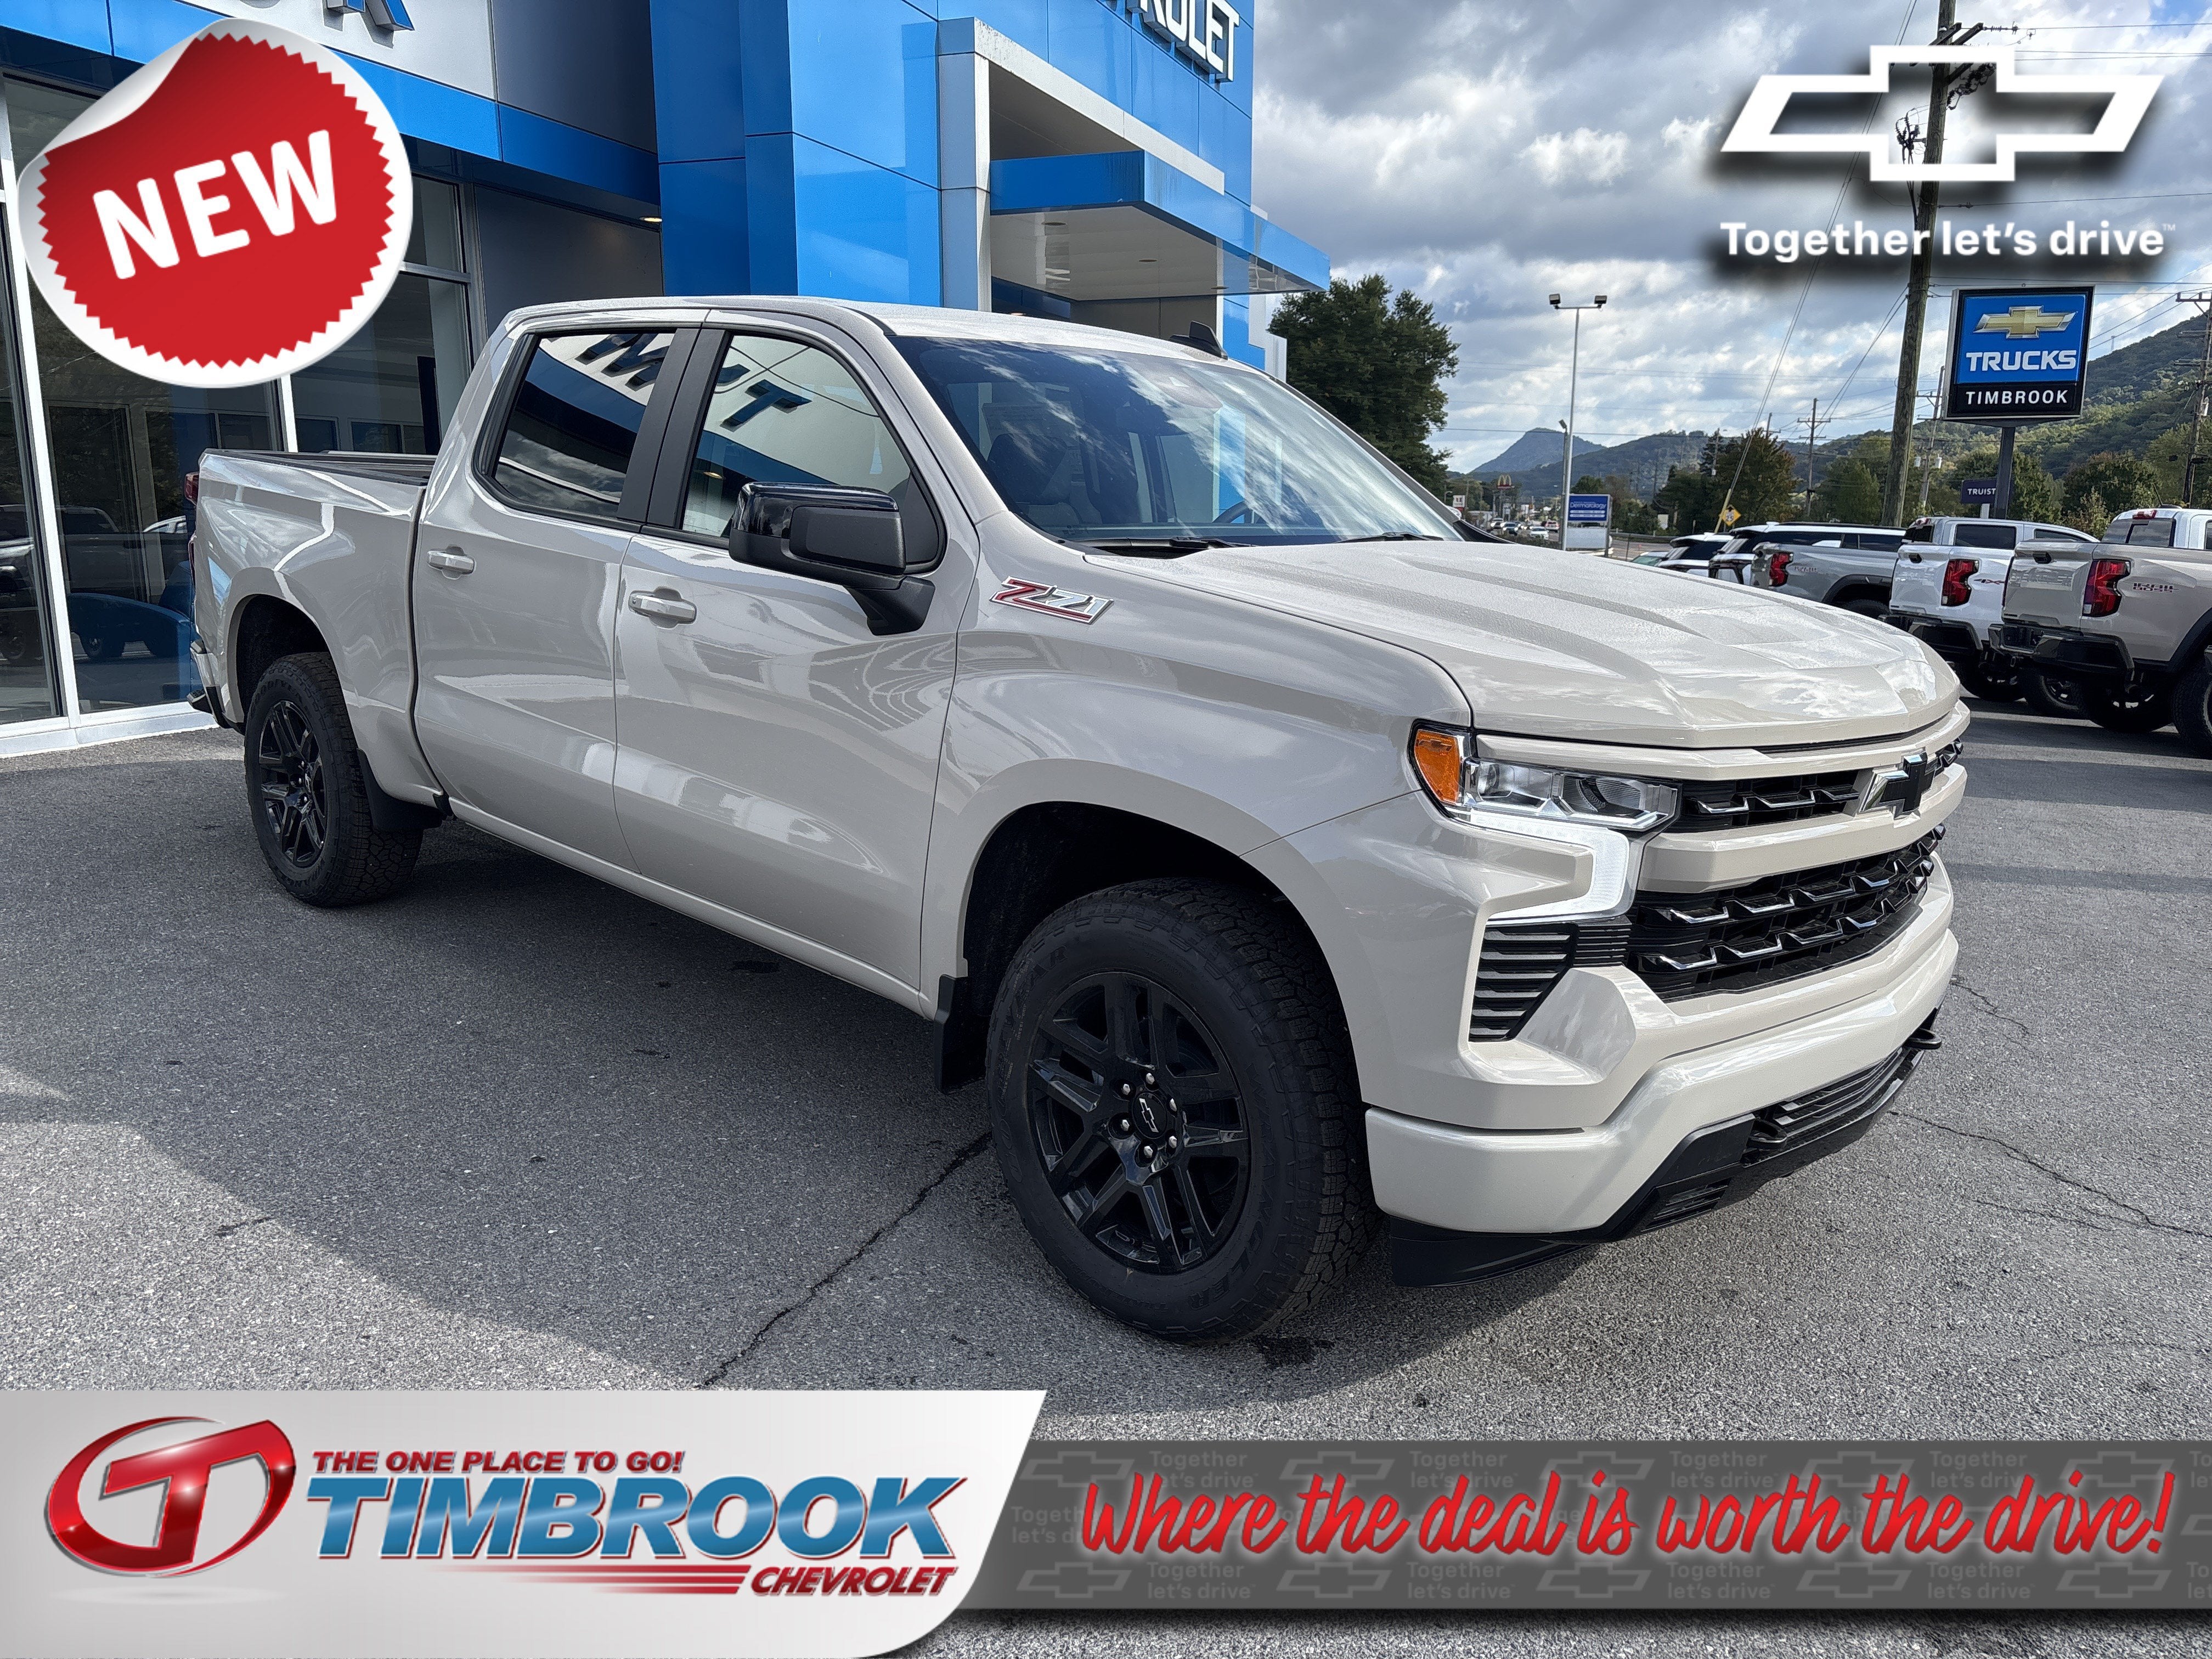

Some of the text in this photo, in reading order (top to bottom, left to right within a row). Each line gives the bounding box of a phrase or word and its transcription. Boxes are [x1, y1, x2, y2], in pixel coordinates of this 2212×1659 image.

[1966, 349, 2077, 372] TRUCKS
[1966, 390, 2068, 405] TIMBROOK
[989, 576, 1114, 625] Z71
